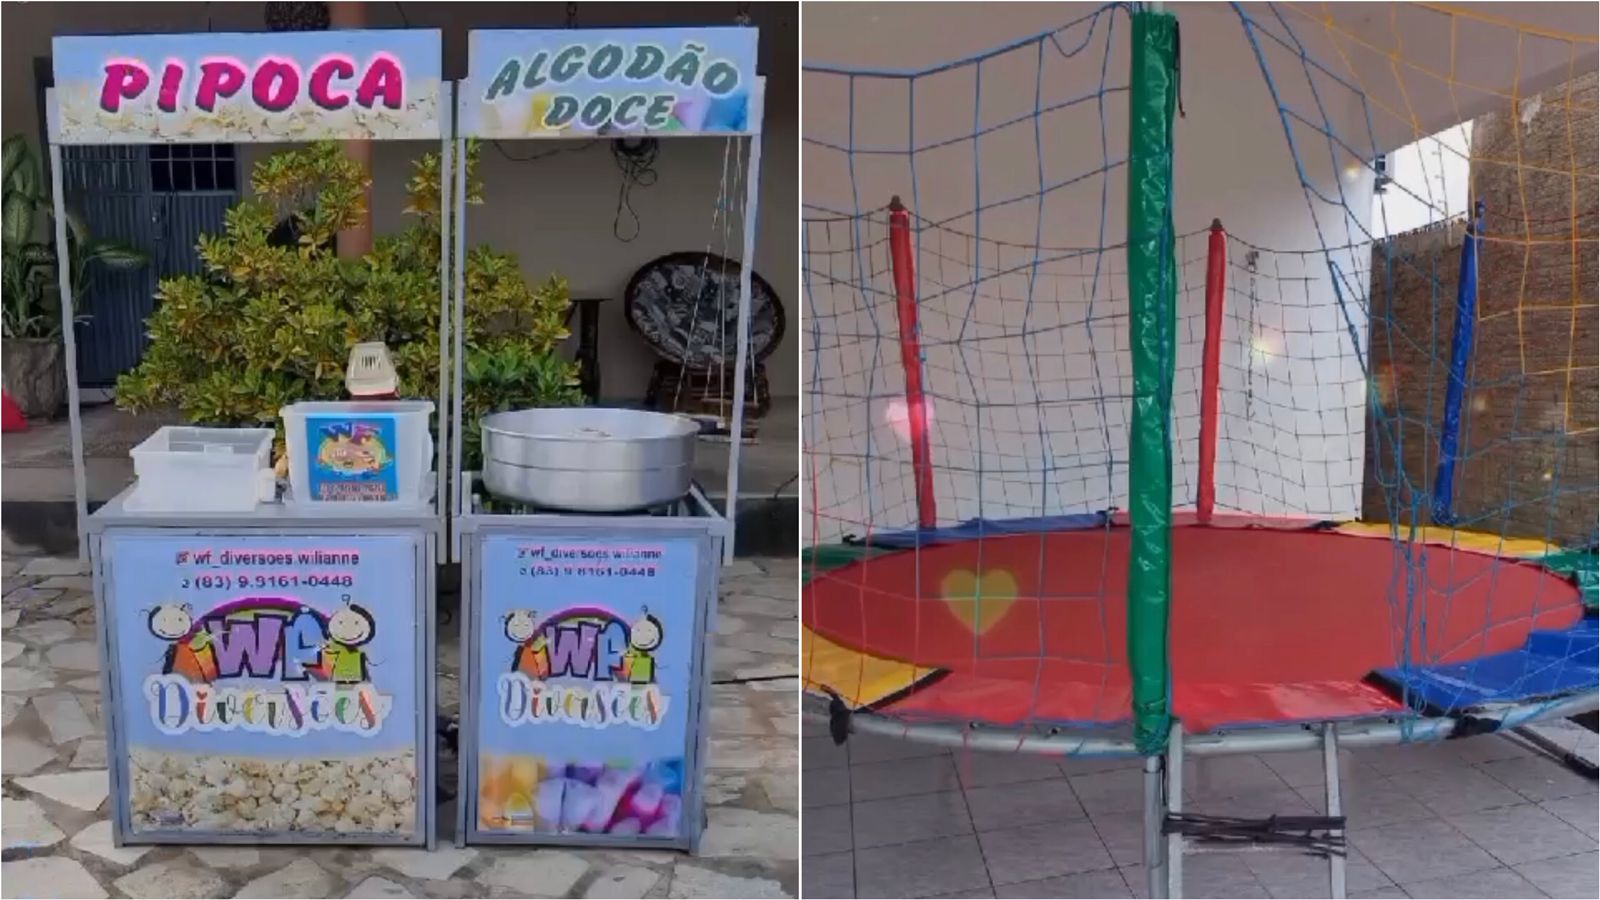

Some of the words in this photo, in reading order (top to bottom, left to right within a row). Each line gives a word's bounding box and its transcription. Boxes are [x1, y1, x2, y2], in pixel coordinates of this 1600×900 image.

[100, 57, 405, 113] PIPOCA
[485, 43, 740, 100] ALGODÃO
[543, 95, 676, 128] DOCE
